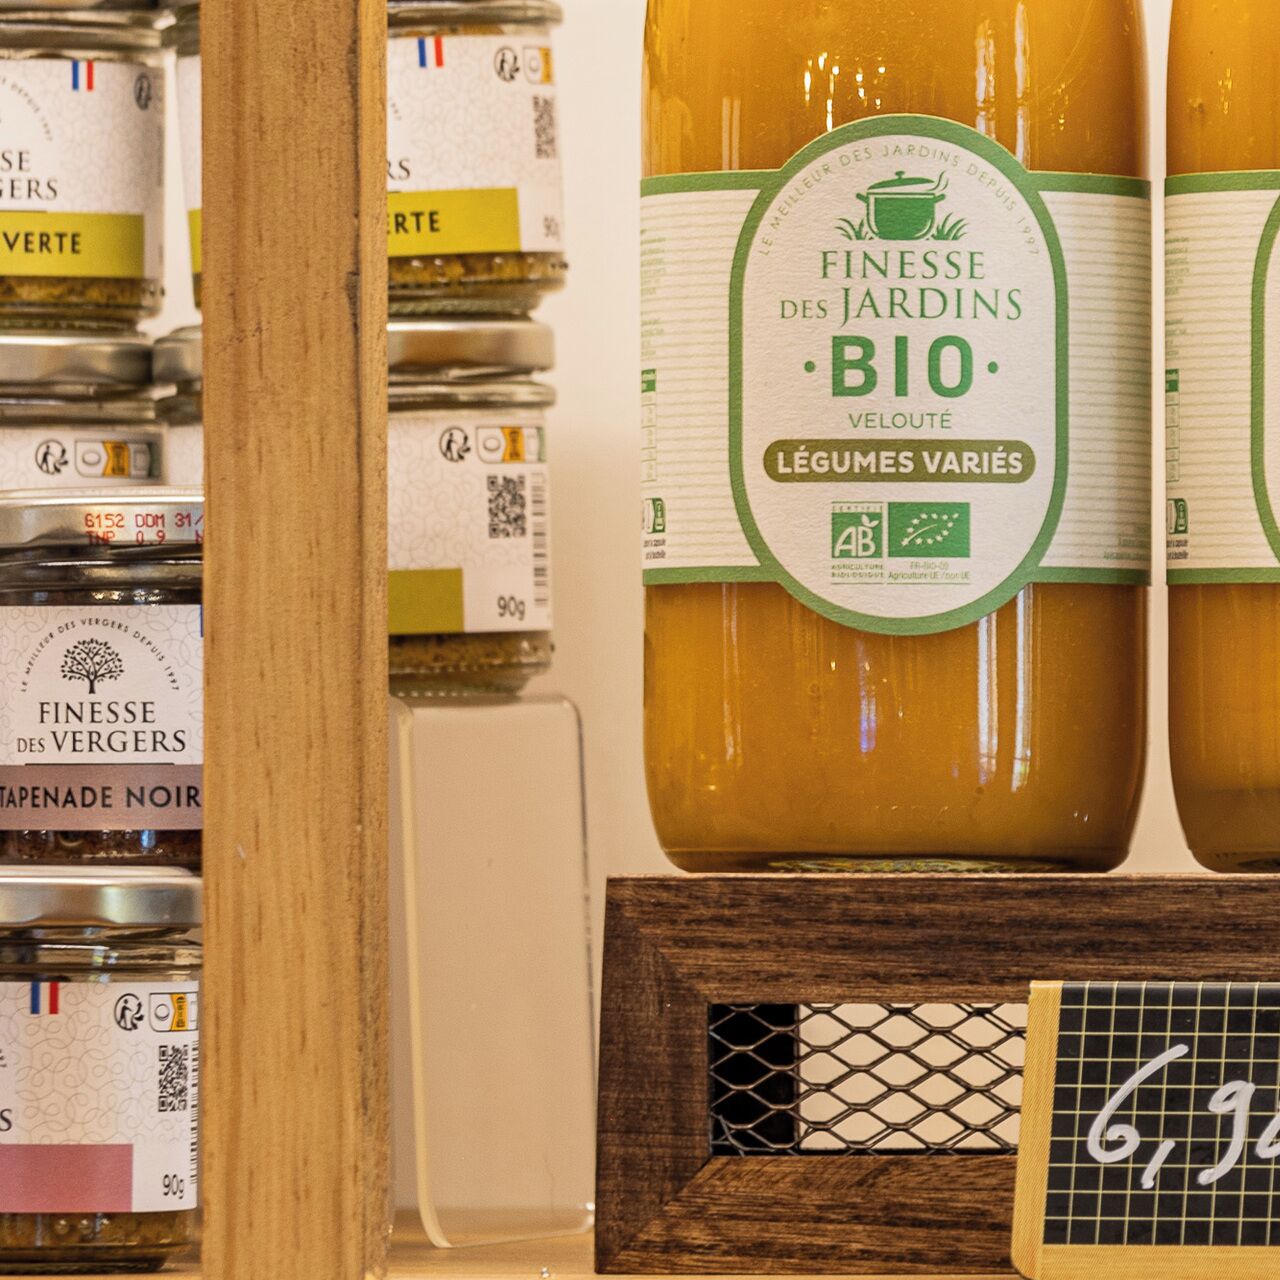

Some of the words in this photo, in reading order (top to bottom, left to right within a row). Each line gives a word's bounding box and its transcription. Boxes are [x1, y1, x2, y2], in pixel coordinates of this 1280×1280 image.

[840, 144, 873, 168] DES
[882, 143, 960, 168] JARDINS
[965, 163, 1017, 213] DEPUIS
[387, 211, 440, 235] RTE
[3, 232, 81, 254] VERTE
[820, 250, 985, 279] FINESSE
[780, 299, 827, 319] DES
[839, 288, 1022, 328] JARDINS
[832, 335, 974, 397] BIO
[848, 409, 952, 429] VELOUTÉ
[777, 446, 914, 474] LÉGUMES
[923, 446, 1023, 475] VARIÉS
[834, 526, 875, 556] AB
[497, 596, 526, 621] 90g
[58, 622, 76, 634] DES
[80, 617, 129, 632] VERGERS
[132, 630, 165, 662] DEPUIS
[39, 701, 156, 724] FINESSE
[17, 738, 45, 753] DES
[52, 730, 186, 753] VERGERS
[126, 786, 201, 808] NOIR
[163, 1174, 185, 1199] 90g
